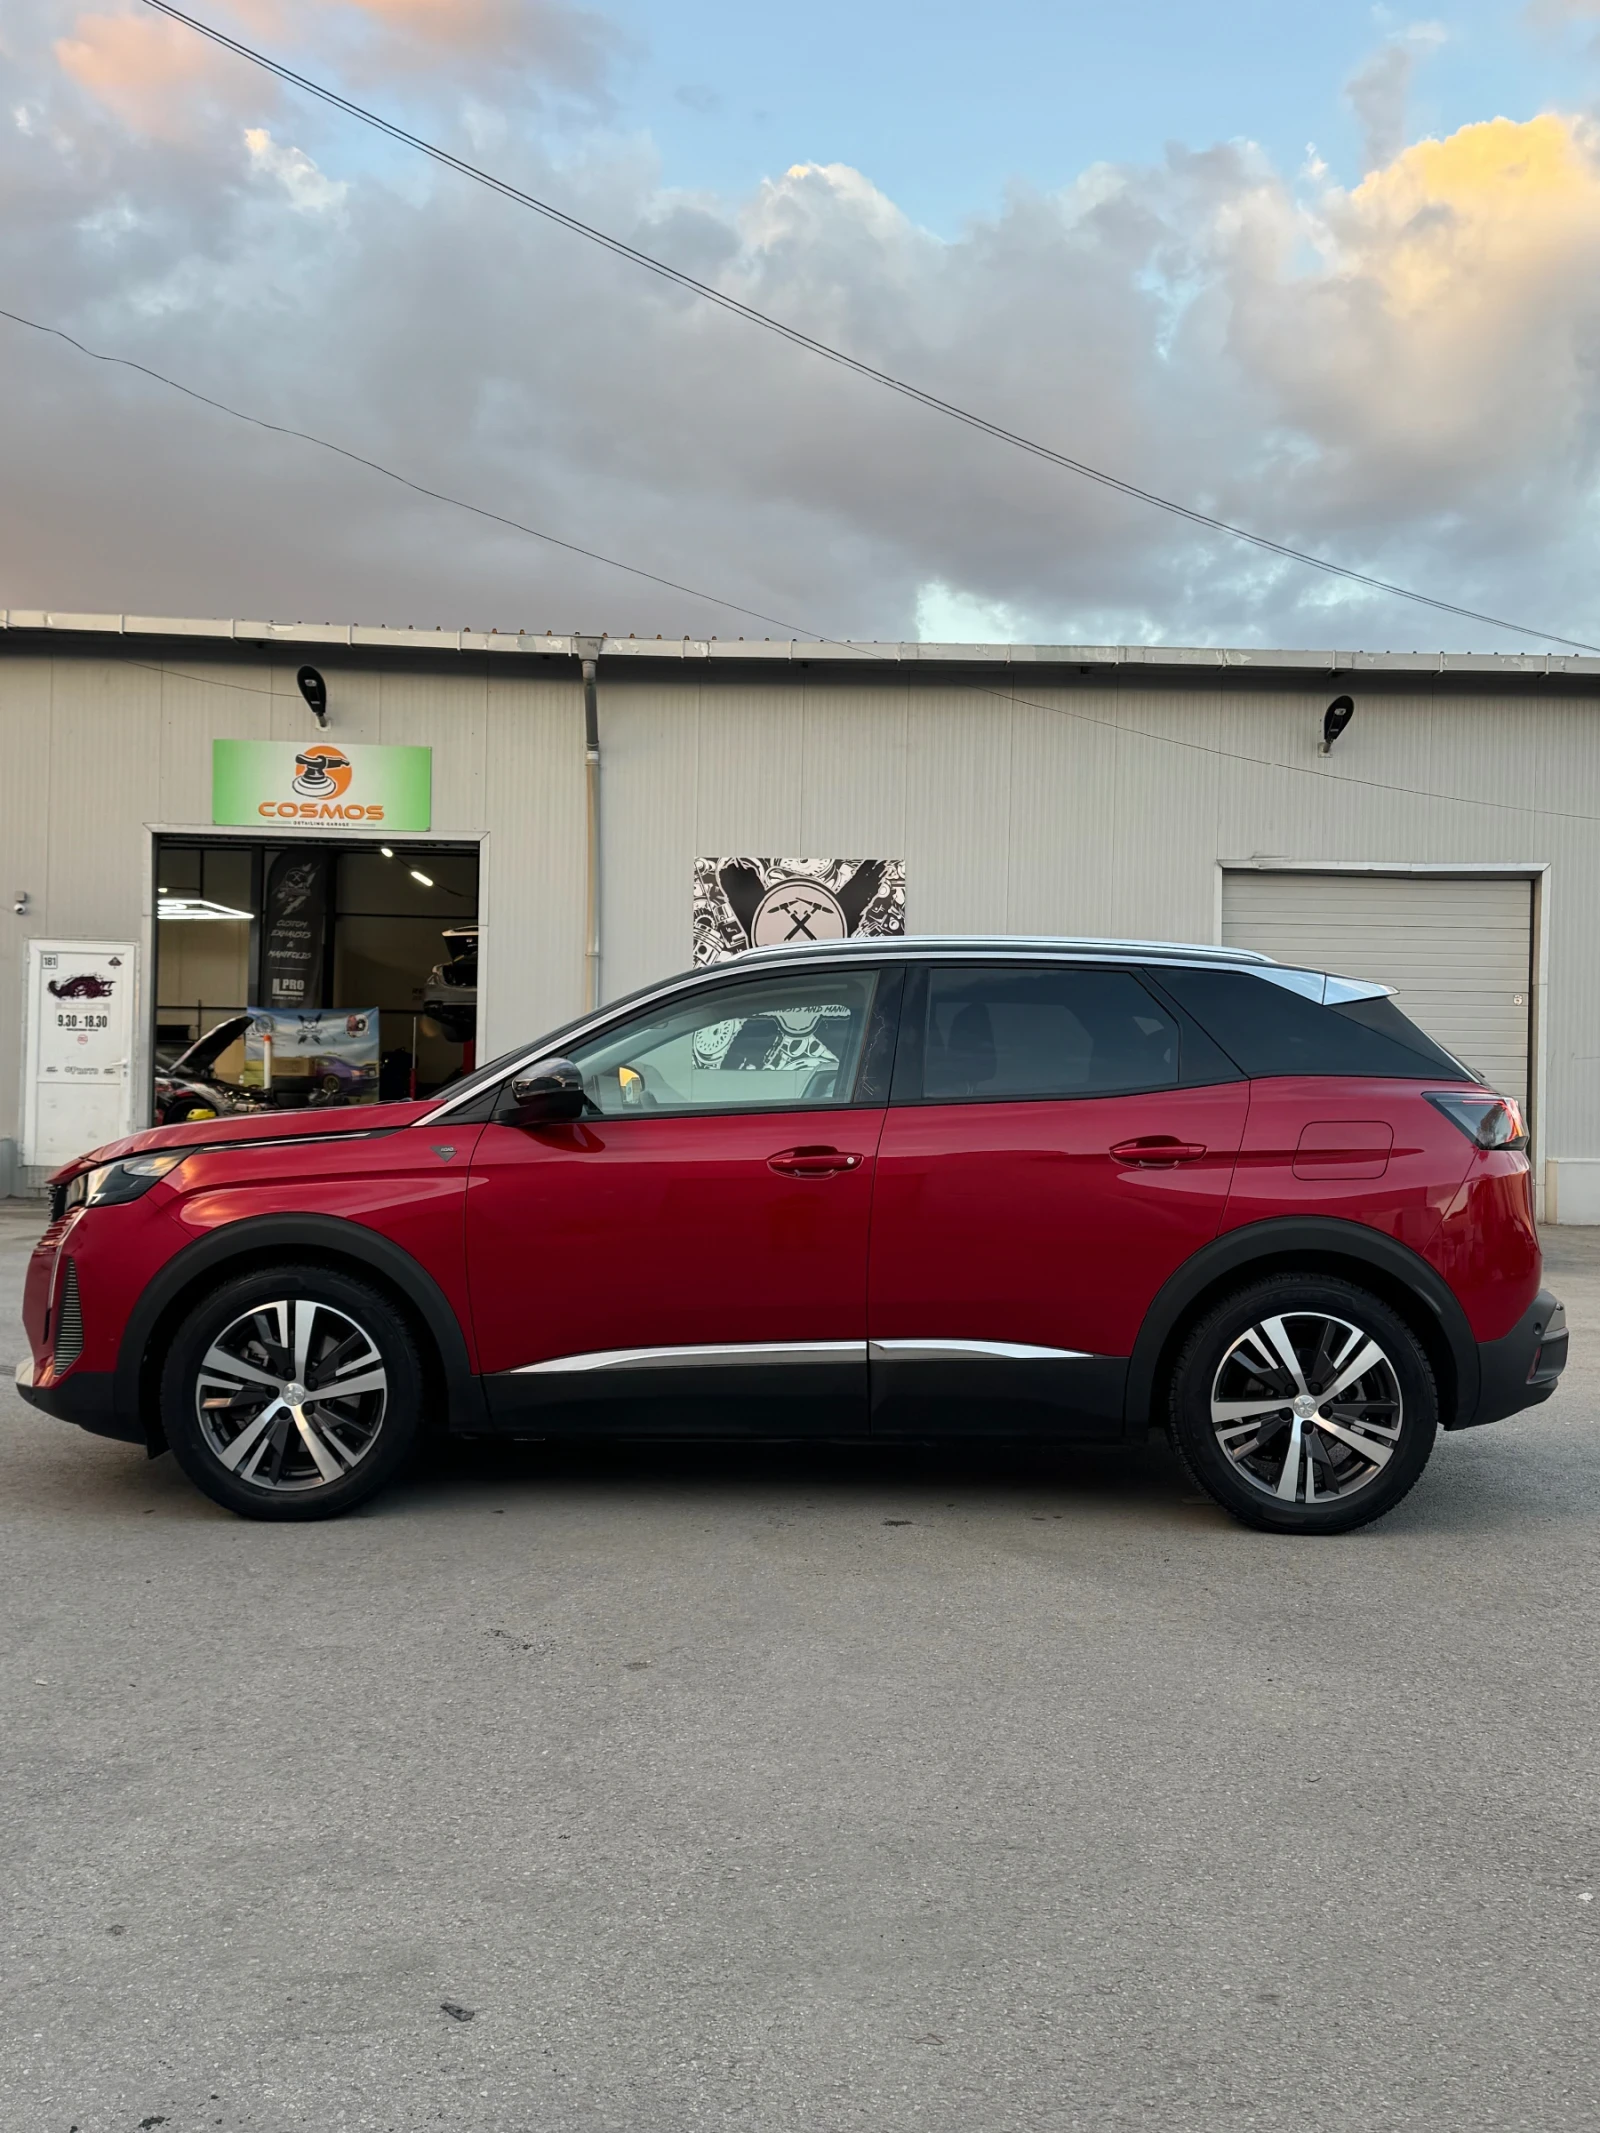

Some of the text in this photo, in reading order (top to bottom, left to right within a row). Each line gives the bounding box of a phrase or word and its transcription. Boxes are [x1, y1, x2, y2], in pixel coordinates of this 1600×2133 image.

[258, 802, 385, 820] COSMOS
[276, 919, 308, 928] CUSTOM
[268, 950, 312, 959] MANIFOLDS
[44, 957, 56, 966] 181
[282, 978, 305, 990] PRO
[57, 1014, 77, 1027] 9.30
[84, 1015, 107, 1028] 18.30
